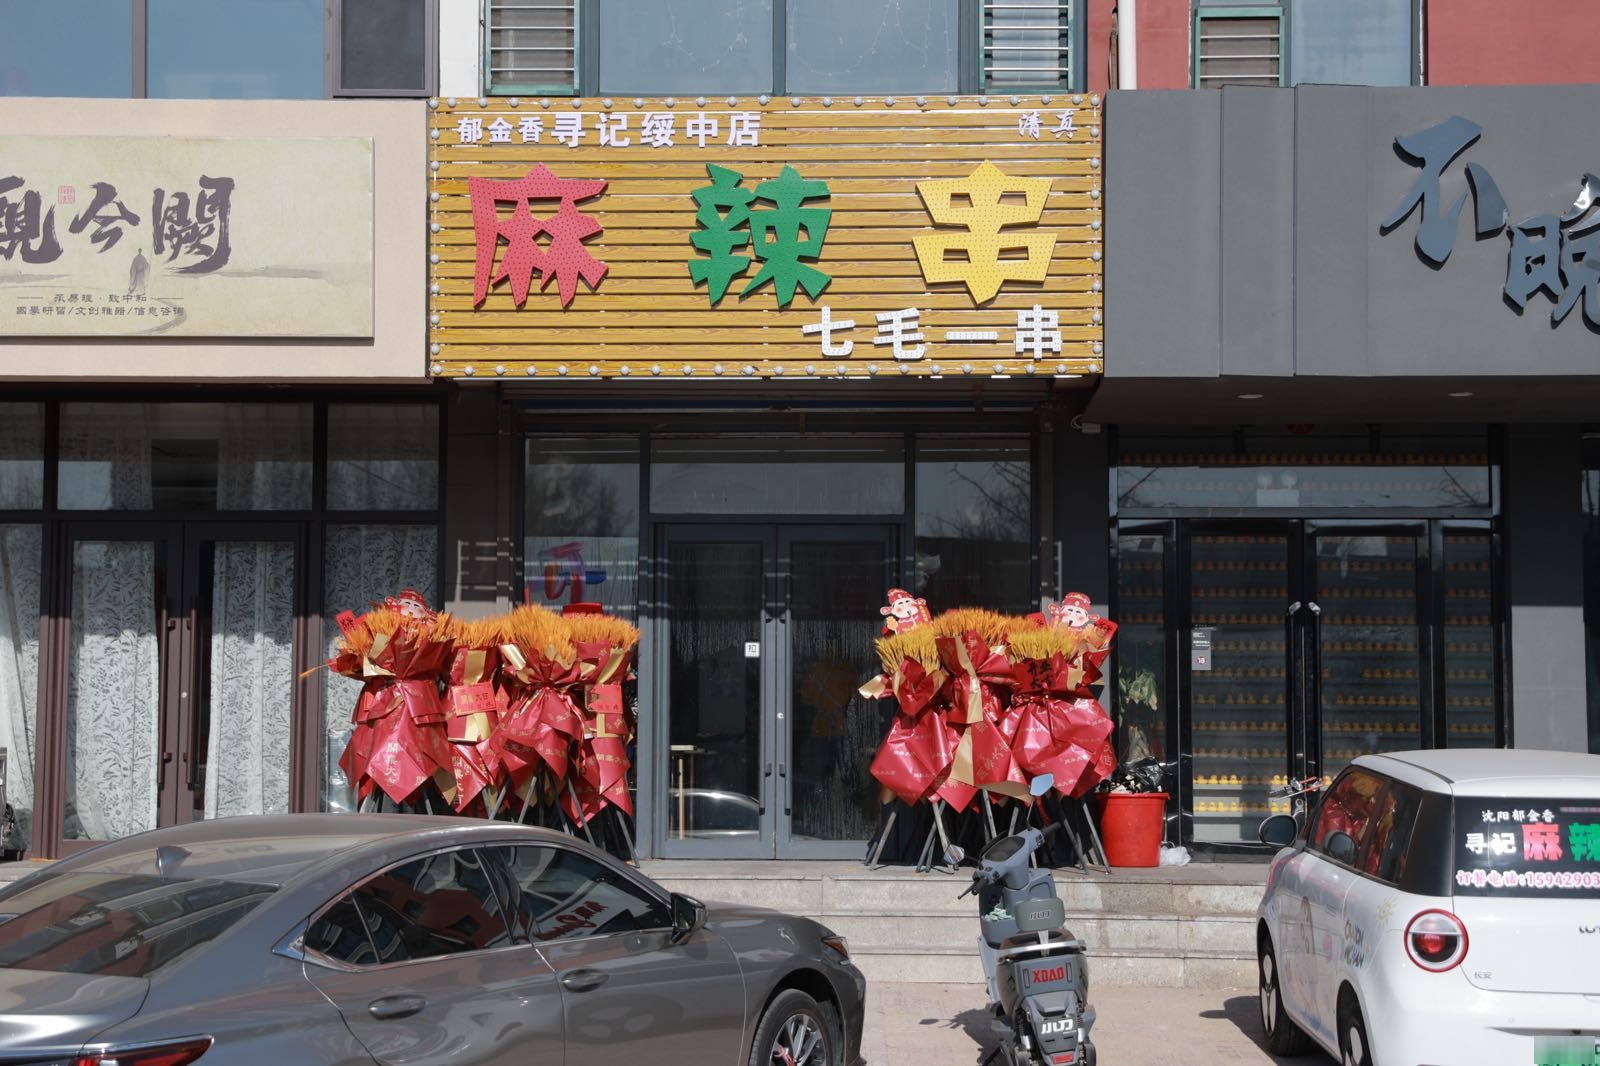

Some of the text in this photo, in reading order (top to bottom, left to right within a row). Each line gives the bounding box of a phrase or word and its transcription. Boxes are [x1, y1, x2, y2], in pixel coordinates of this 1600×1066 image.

[457, 112, 761, 148] 郁金香寻记绥中店
[1018, 110, 1078, 140] 清真
[468, 160, 1058, 310] 麻辣串
[802, 304, 1063, 361] 七毛一串
[1482, 808, 1555, 823] 沈阳郁金香
